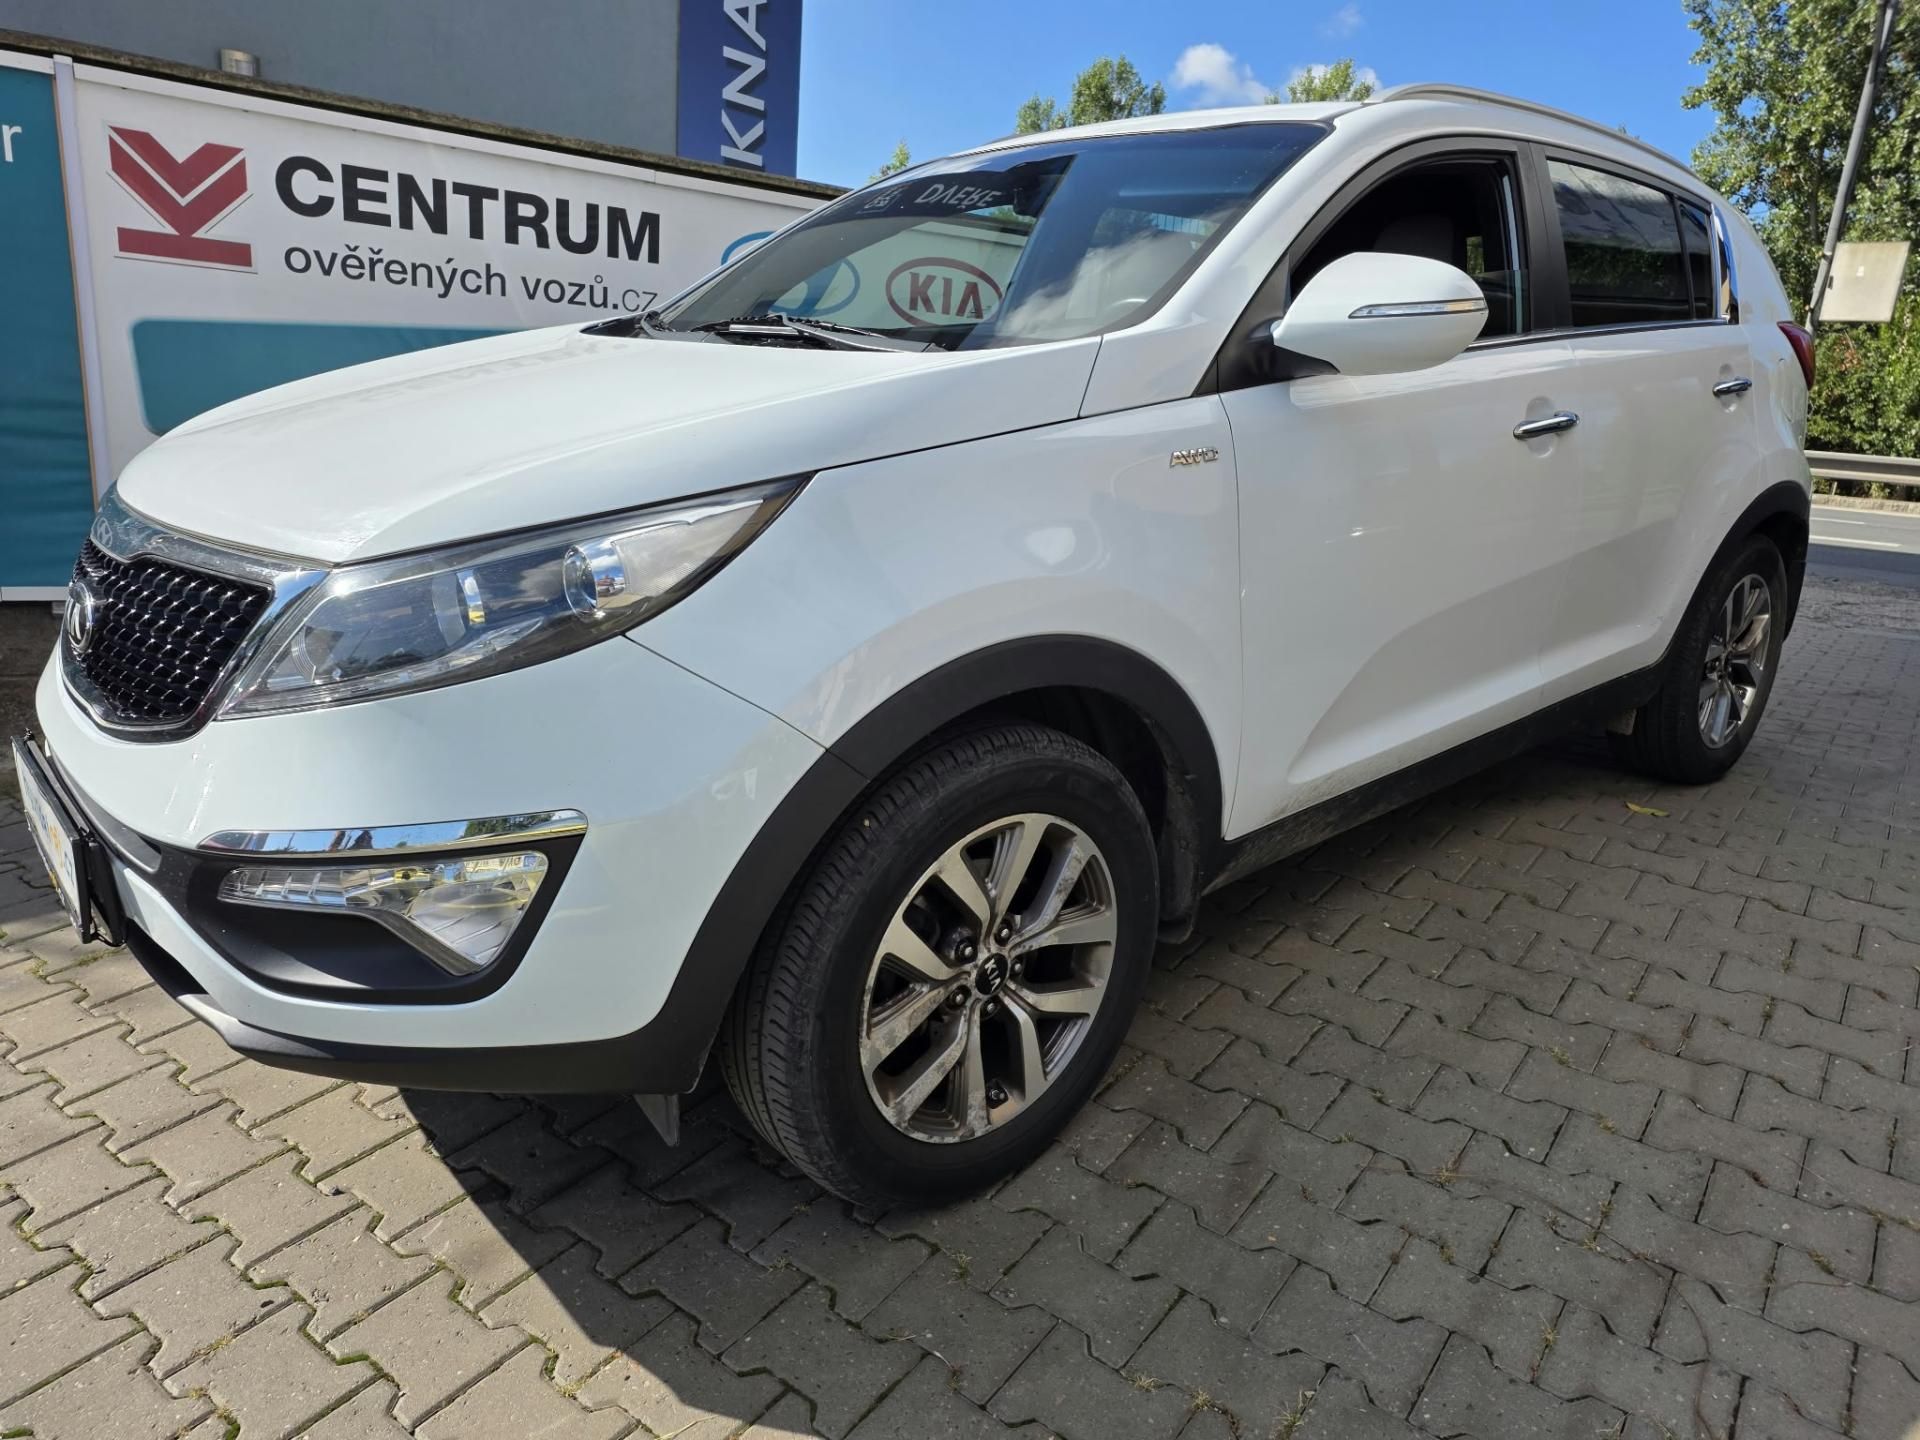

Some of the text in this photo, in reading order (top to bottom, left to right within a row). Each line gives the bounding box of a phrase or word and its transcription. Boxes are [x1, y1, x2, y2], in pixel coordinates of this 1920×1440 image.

[275, 155, 661, 264] CENTRUM
[283, 243, 658, 312] ověřených vozů.cz
[908, 271, 984, 320] KIA
[984, 958, 1001, 991] KIA
